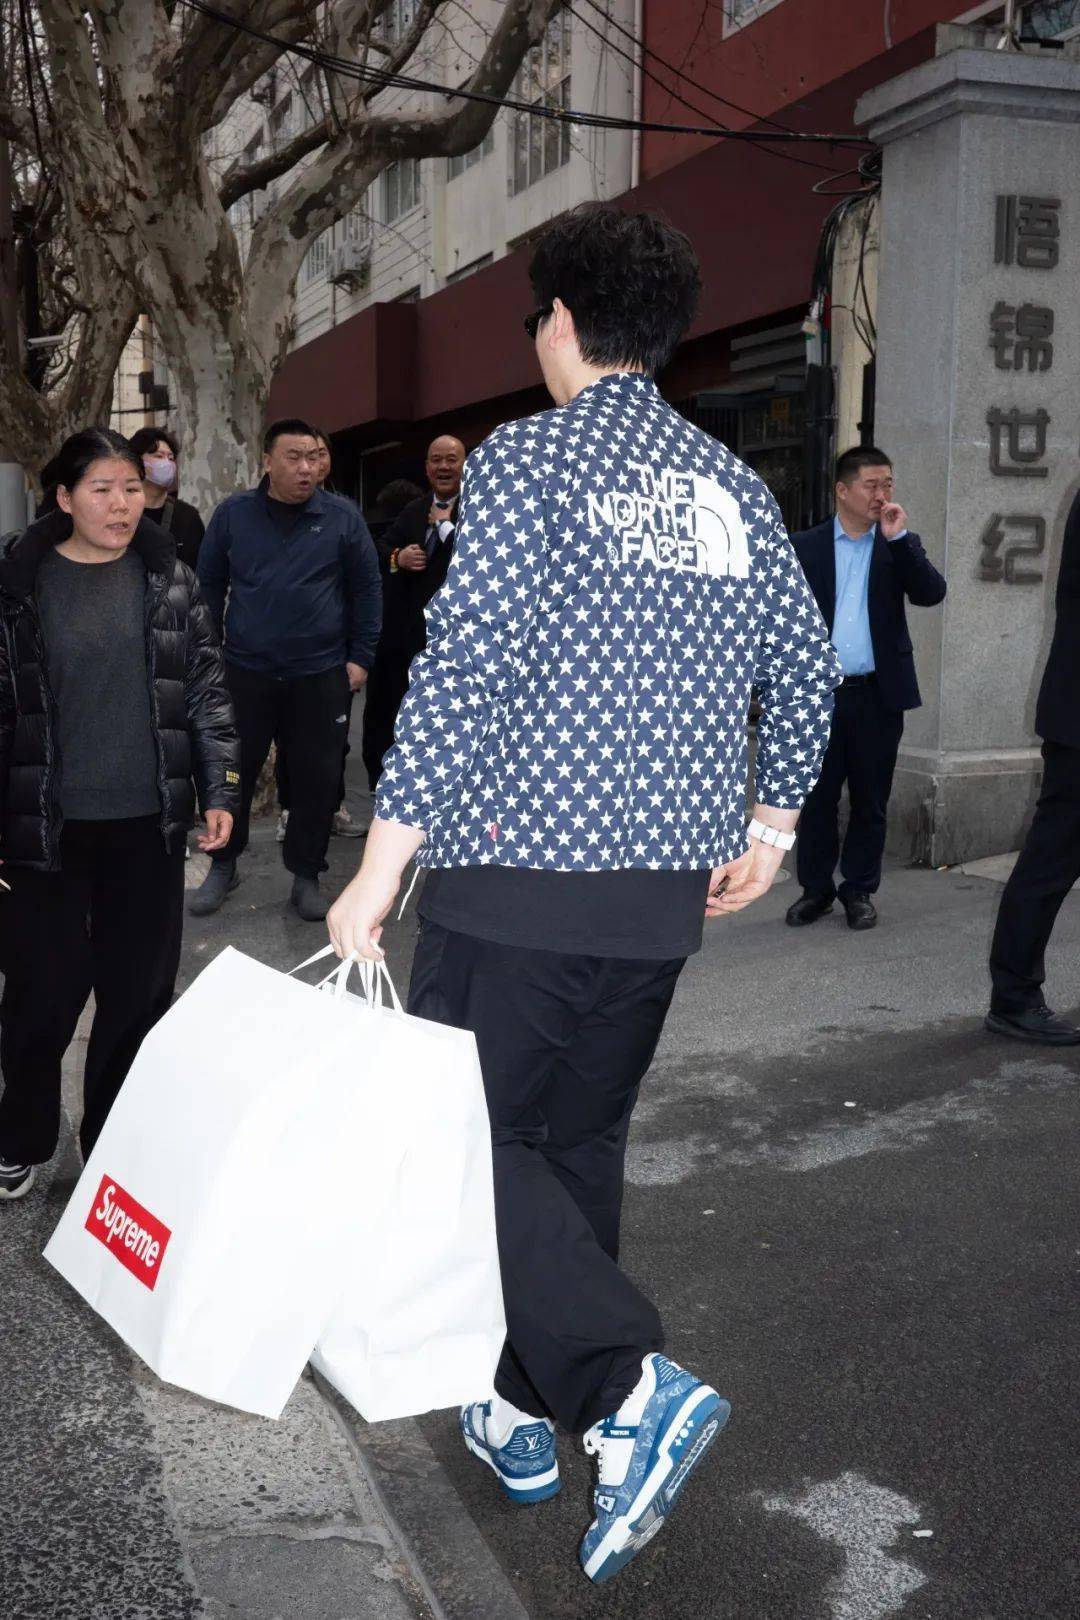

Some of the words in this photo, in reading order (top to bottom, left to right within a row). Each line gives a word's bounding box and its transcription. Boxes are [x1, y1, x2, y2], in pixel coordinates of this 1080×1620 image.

[977, 194, 1061, 585] 悟锦世纪
[632, 462, 695, 506] THE
[586, 489, 697, 540] NORTH
[622, 530, 698, 574] FACE
[96, 1184, 160, 1268] Supreme
